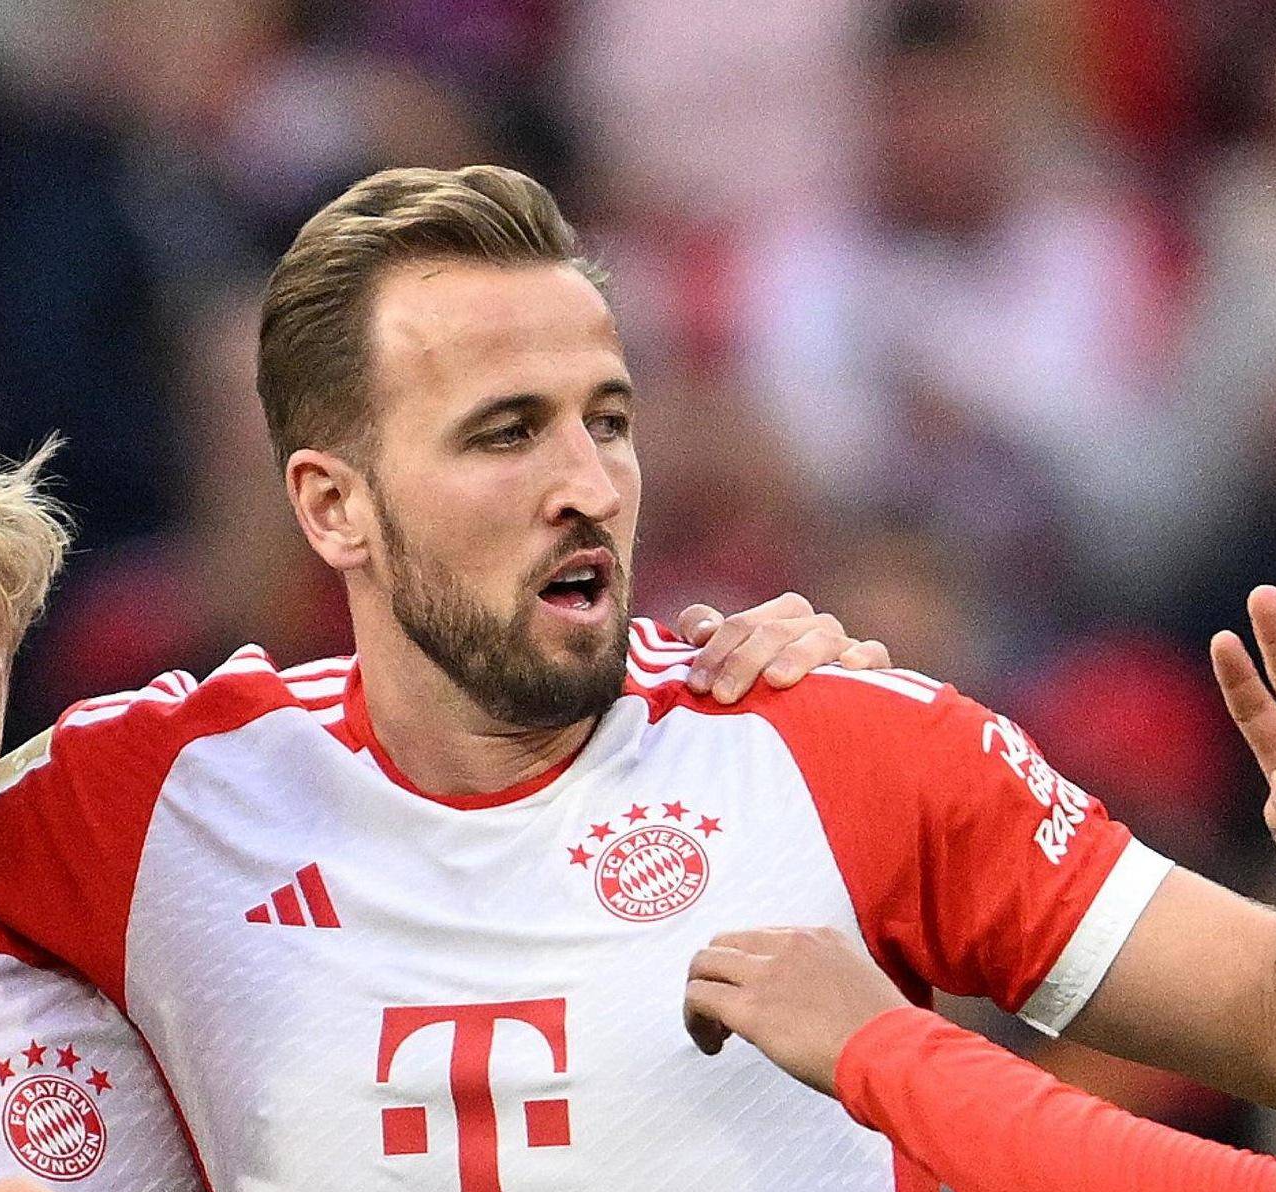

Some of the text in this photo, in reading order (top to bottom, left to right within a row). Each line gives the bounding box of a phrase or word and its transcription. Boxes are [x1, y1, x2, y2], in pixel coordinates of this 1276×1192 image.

[602, 852, 623, 879] FC
[621, 830, 696, 859] BAYERN
[9, 1101, 27, 1127] FC
[23, 1081, 92, 1117] BAYERN
